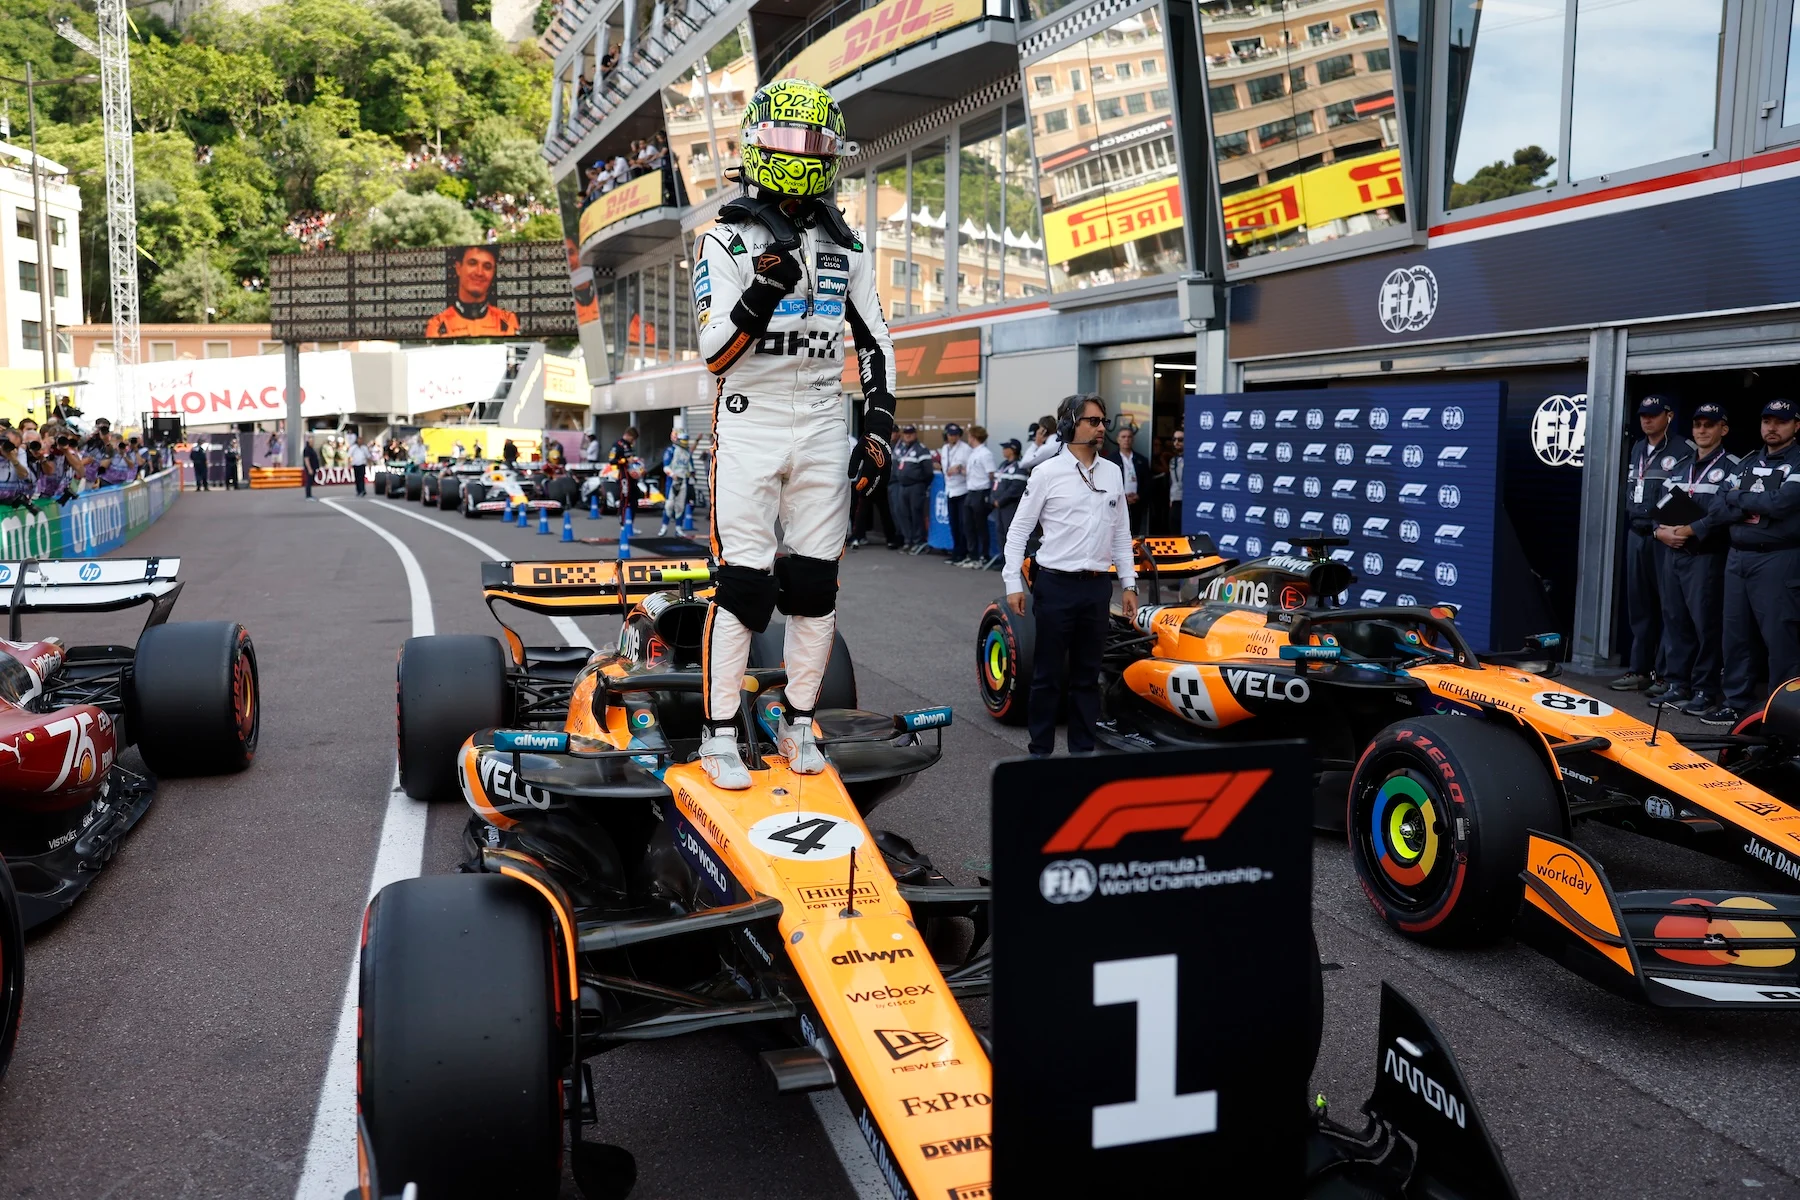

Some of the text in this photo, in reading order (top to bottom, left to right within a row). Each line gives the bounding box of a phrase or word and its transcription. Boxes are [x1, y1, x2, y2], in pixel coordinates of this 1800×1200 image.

[842, 0, 932, 66] DHL
[784, 179, 806, 188] Android
[603, 184, 640, 219] DHL
[818, 278, 845, 294] allwyn
[729, 399, 742, 412] 4
[71, 496, 122, 554] aramco
[81, 563, 101, 582] hp
[1268, 556, 1313, 572] allwyn
[533, 567, 597, 584] OKX
[1245, 643, 1268, 656] CISCO
[1304, 648, 1337, 660] allwyn
[1226, 668, 1310, 704] VELO
[1437, 679, 1487, 702] RICHARD
[1489, 696, 1527, 715] MILLE
[1541, 691, 1600, 717] 81
[913, 712, 946, 726] allwyn
[514, 734, 559, 749] allwyn
[1613, 729, 1651, 738] Hilton
[1413, 735, 1465, 805] ZERO
[1560, 766, 1592, 785] cLaren
[1667, 761, 1714, 771] allwyn
[677, 787, 732, 856] RICHARD MILLE
[767, 818, 838, 855] 4
[1743, 836, 1773, 867] JACK
[687, 833, 727, 893] DP WORLD
[1129, 858, 1196, 876] Formula
[1197, 855, 1206, 869] 1
[1100, 867, 1262, 896] World Championship
[1537, 864, 1592, 895] workday
[807, 902, 828, 910] FOR
[831, 948, 914, 965] allwyn
[846, 984, 935, 1004] webex
[1092, 953, 1218, 1149] 1
[900, 1091, 992, 1118] FxPro
